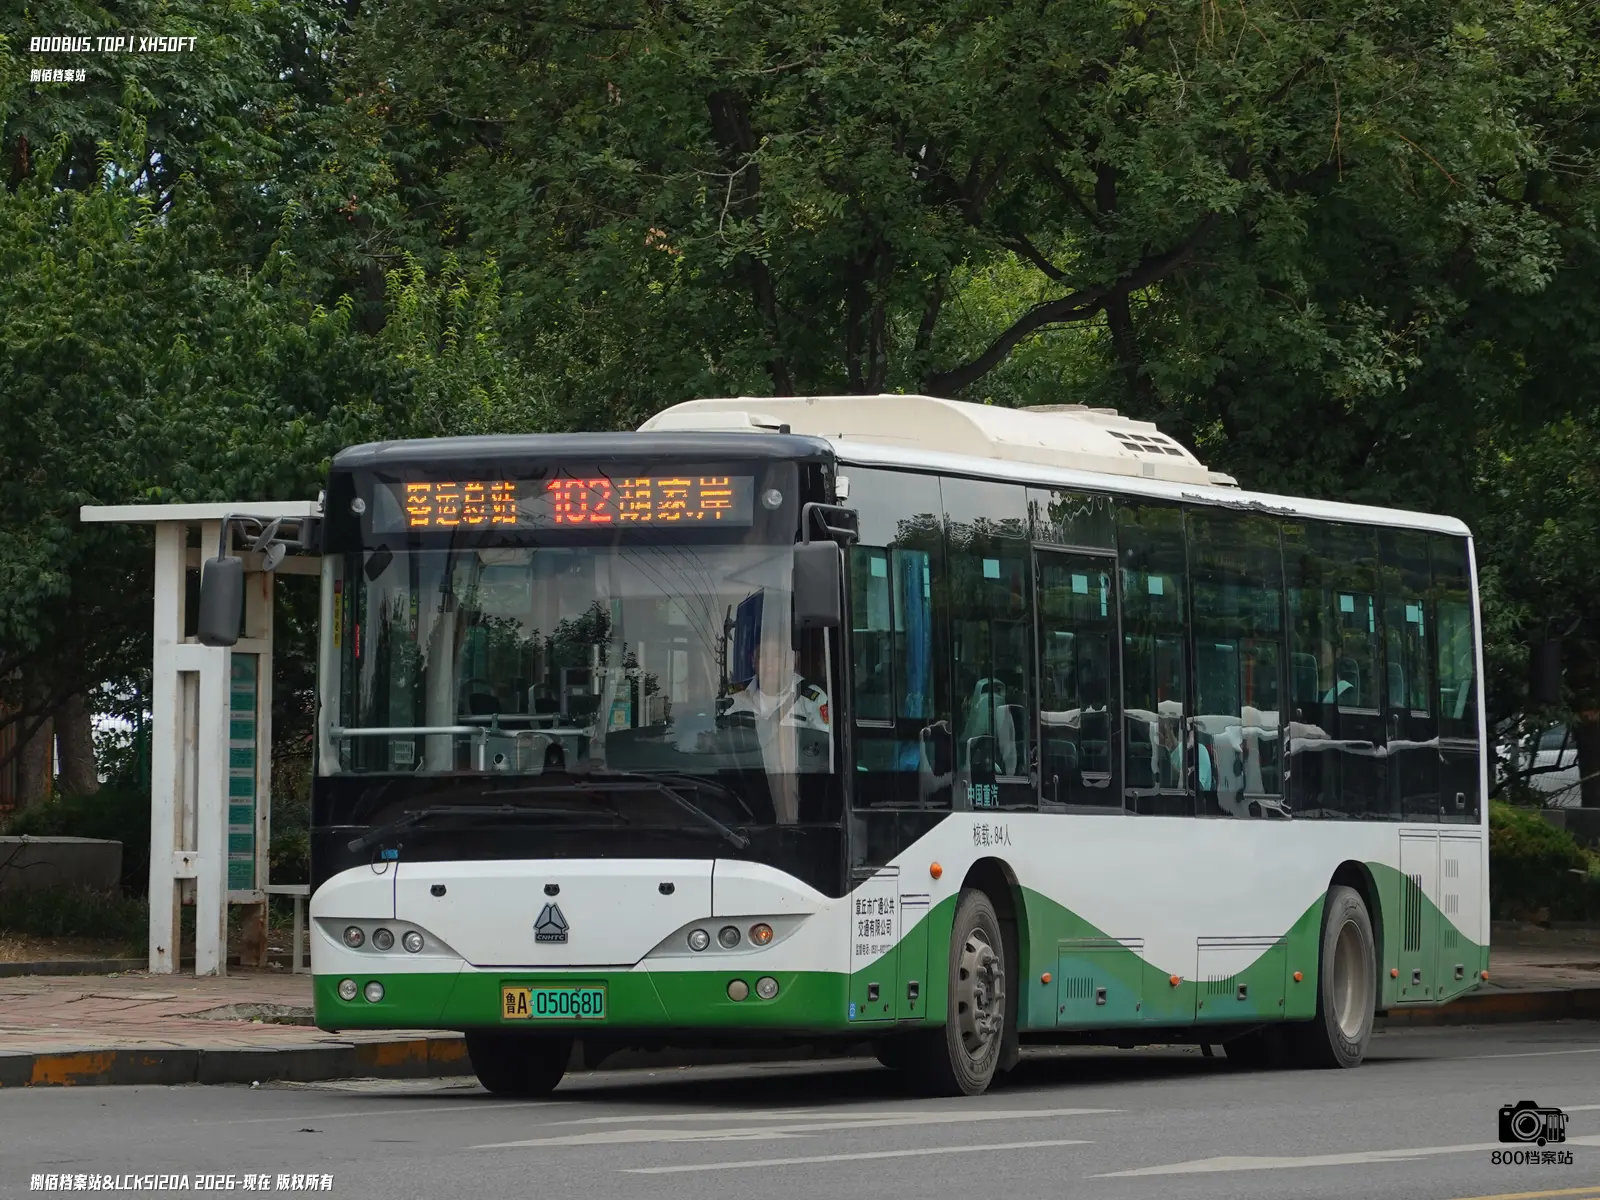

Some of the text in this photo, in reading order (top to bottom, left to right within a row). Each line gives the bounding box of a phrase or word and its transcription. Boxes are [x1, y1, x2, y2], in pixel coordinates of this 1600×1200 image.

[547, 479, 613, 524] 102
[967, 783, 1000, 808] 中国重汽
[855, 897, 895, 916] 章丘市广通公共
[858, 919, 892, 937] 交通有限公司
[505, 991, 603, 1014] 鲁A 05068D
